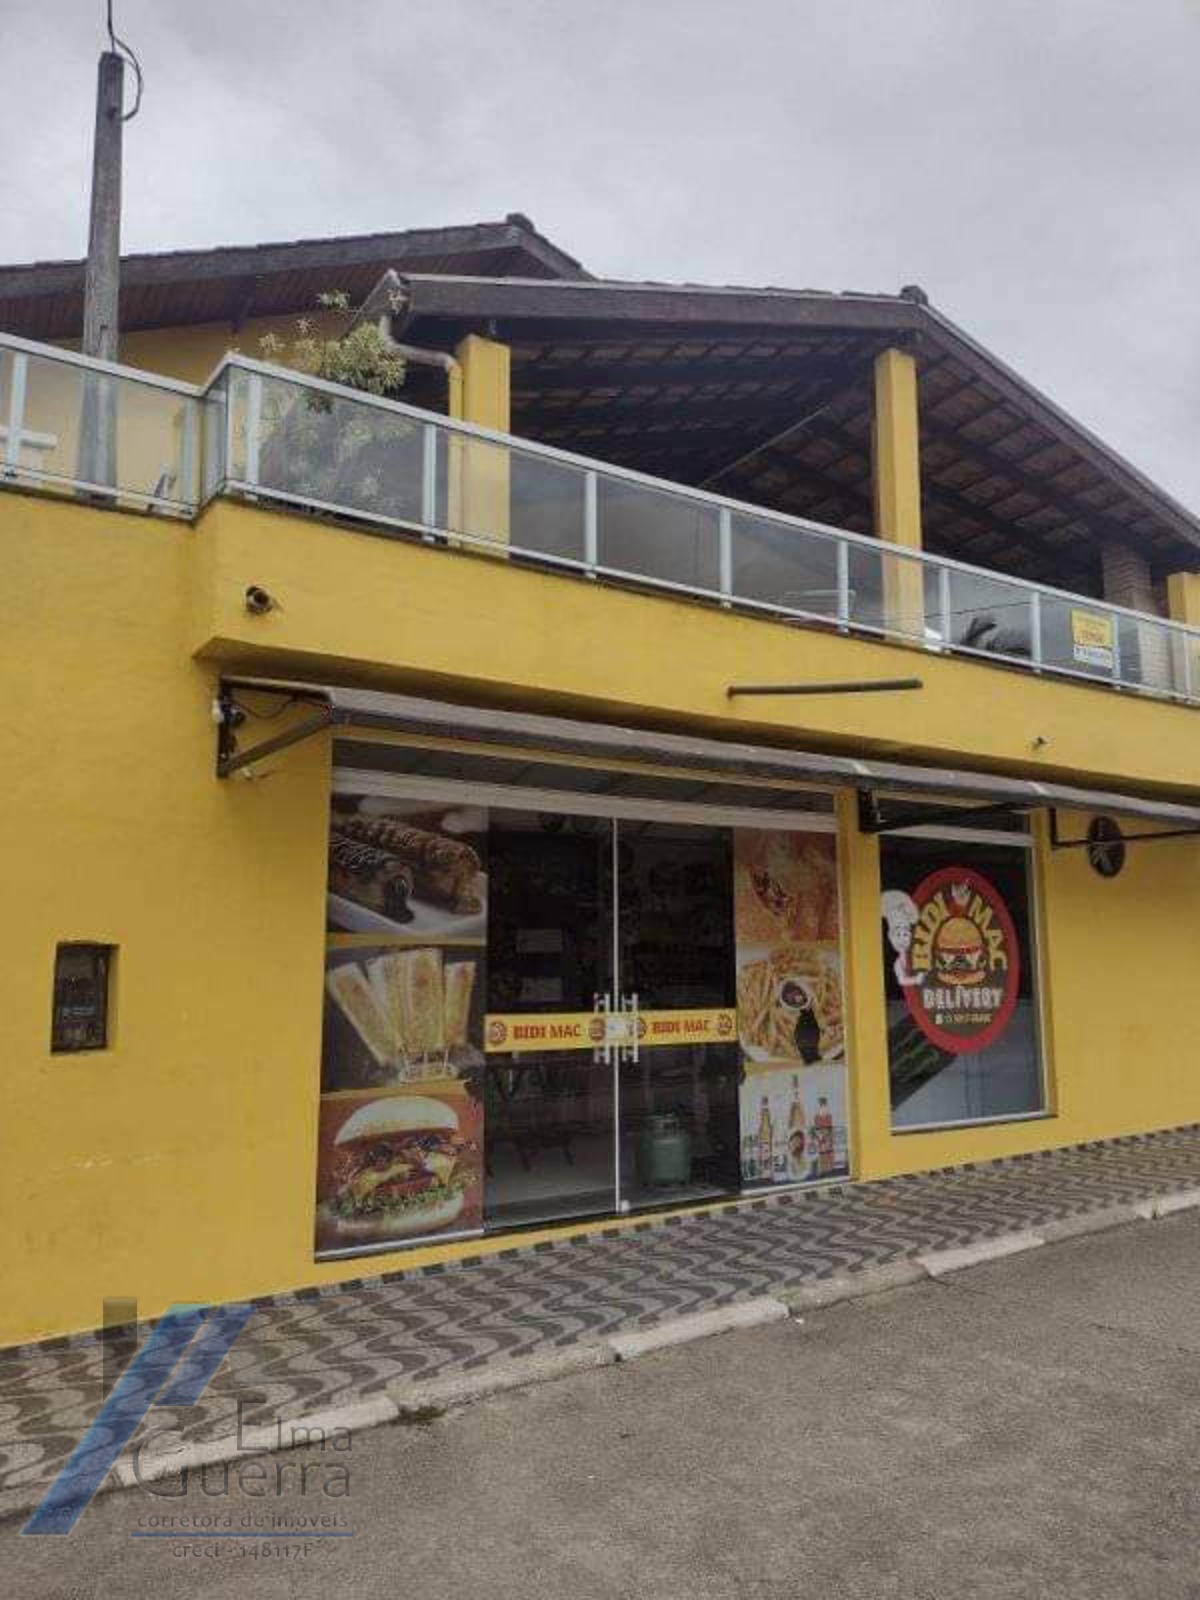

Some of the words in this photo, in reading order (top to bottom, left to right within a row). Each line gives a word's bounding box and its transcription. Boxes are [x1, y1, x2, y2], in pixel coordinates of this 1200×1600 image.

[967, 893, 1008, 971] MAC
[512, 1024, 546, 1039] BIDI
[550, 1023, 581, 1039] MAC
[653, 1020, 680, 1034] BIDI
[684, 1019, 710, 1034] MAC
